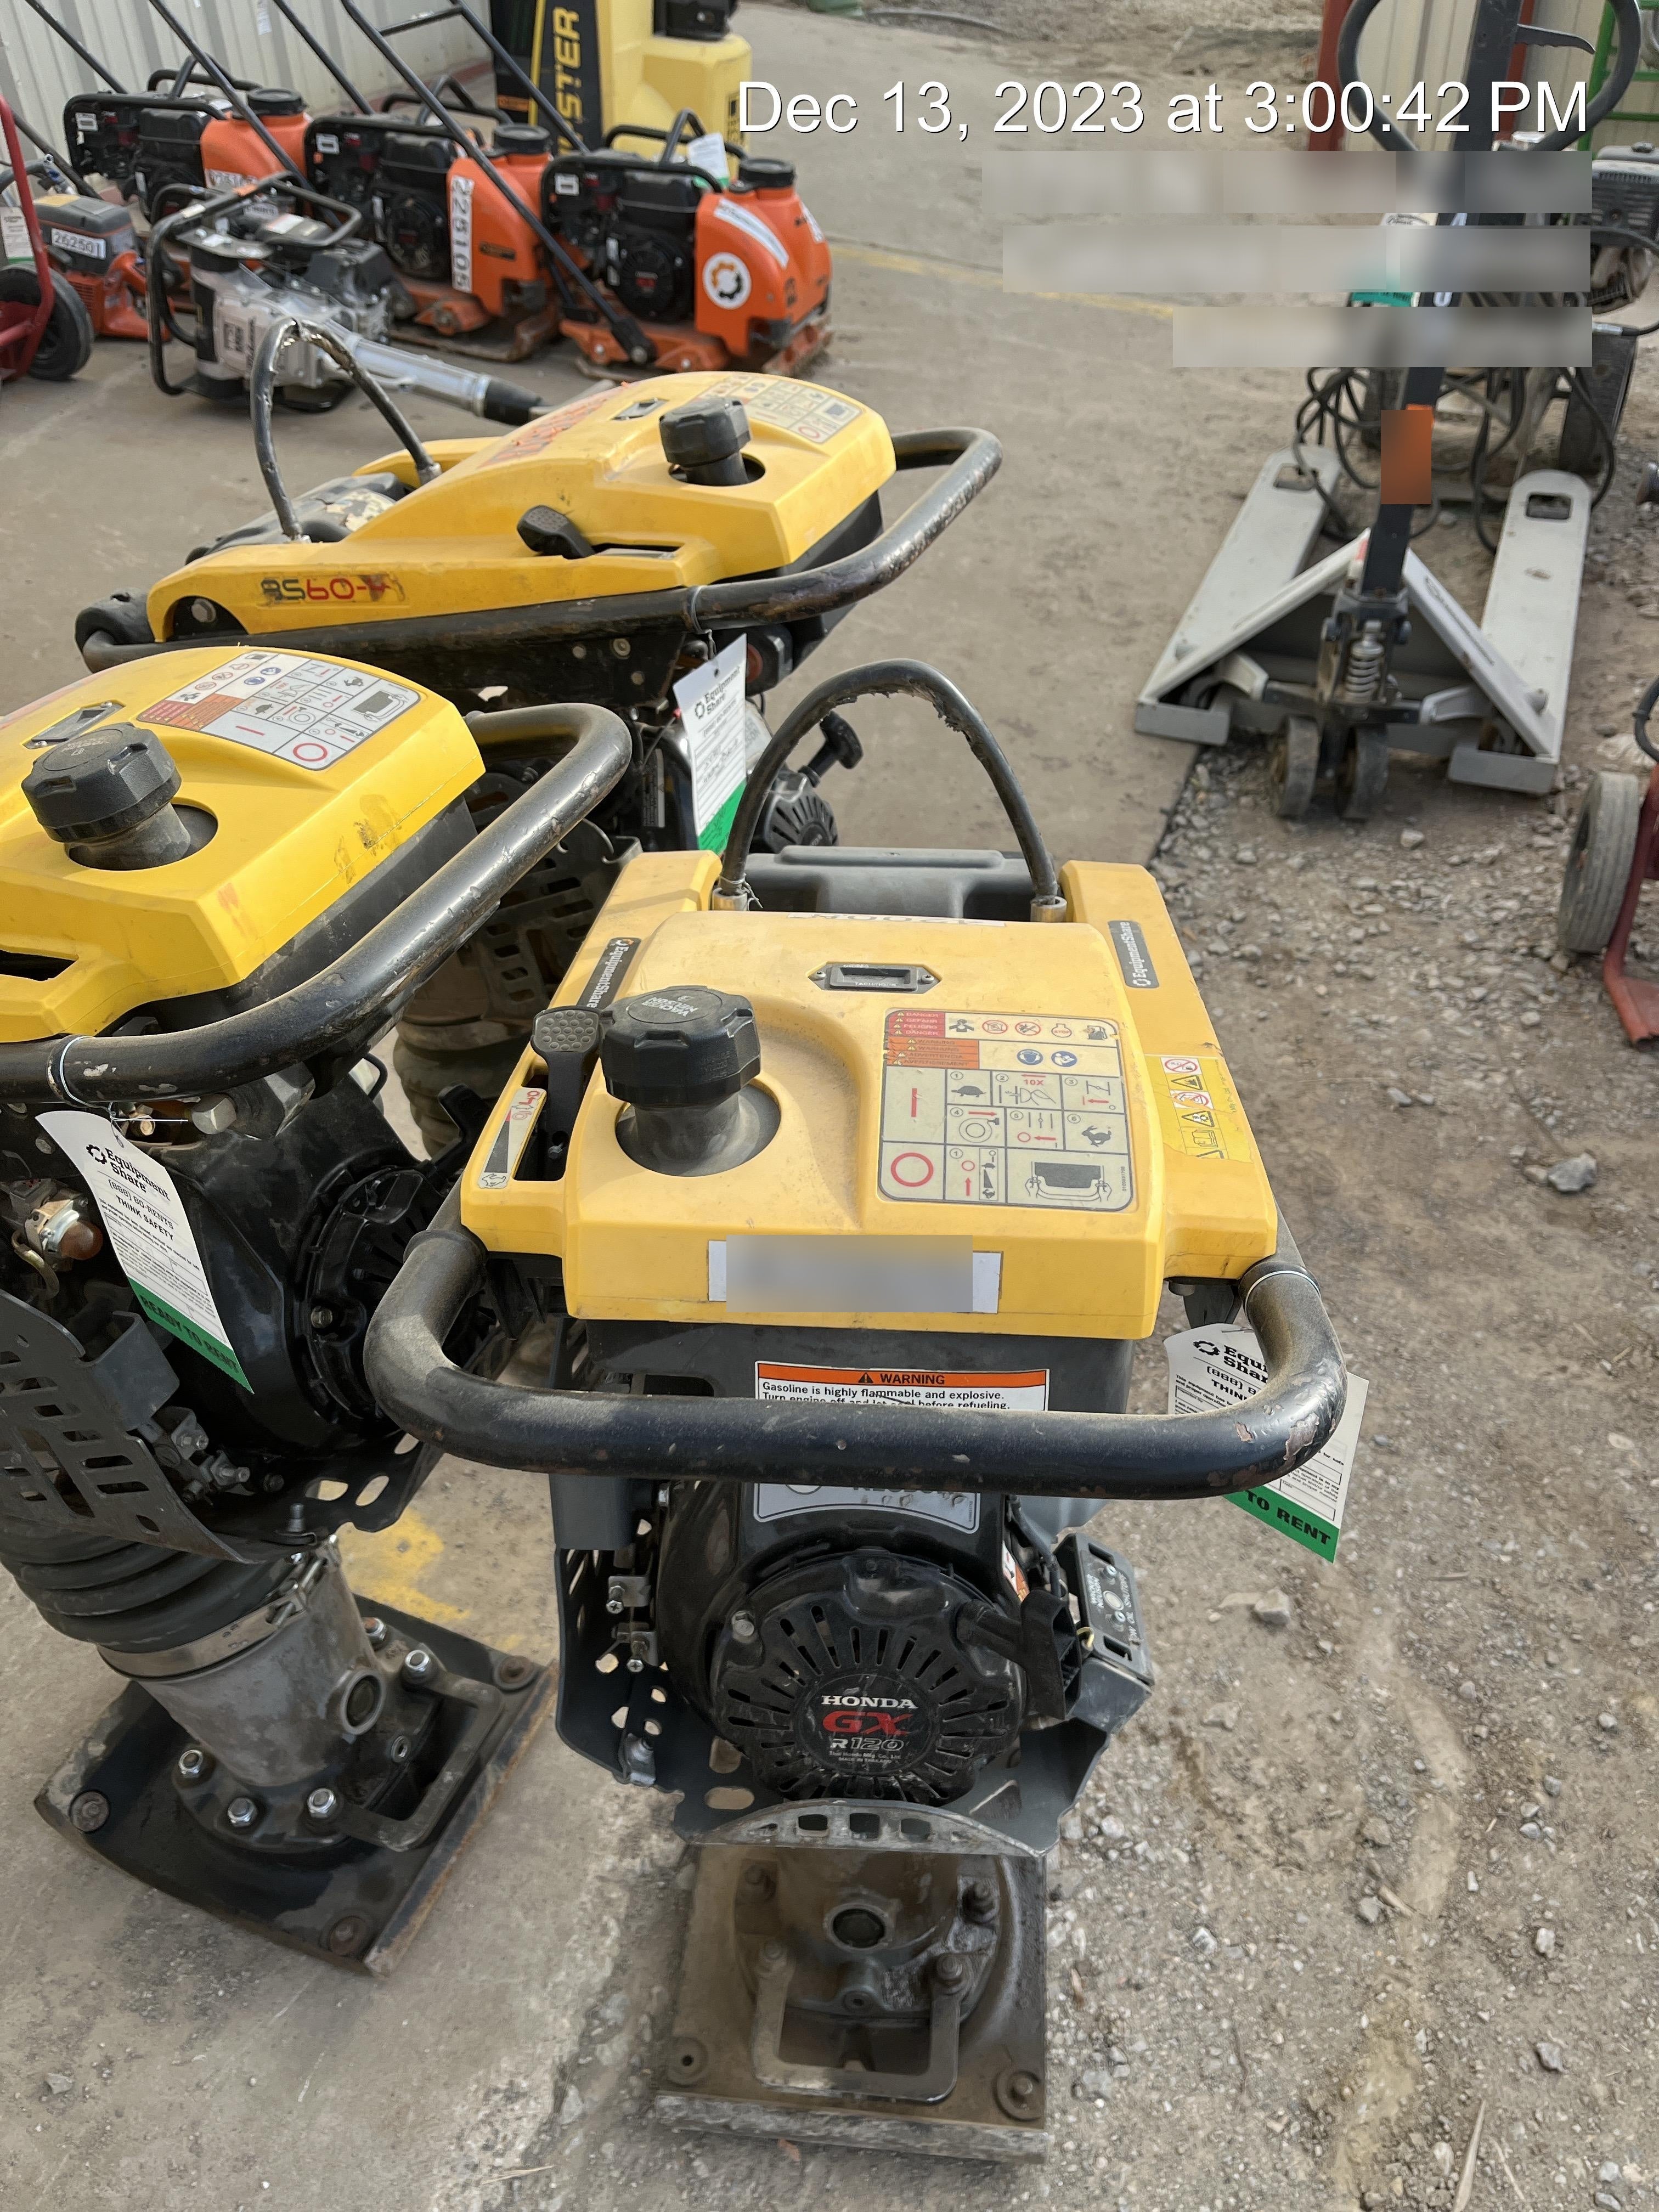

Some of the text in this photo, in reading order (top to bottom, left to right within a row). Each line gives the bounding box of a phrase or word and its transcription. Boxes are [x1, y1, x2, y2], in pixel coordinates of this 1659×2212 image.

[704, 666, 740, 704] Equipment
[707, 693, 726, 714] Share
[1120, 922, 1148, 978] EquipmentShare
[586, 946, 629, 1008] EquipmentShare
[105, 1148, 171, 1201] Equipment
[110, 1161, 146, 1193] Share
[116, 1194, 143, 1218] THINK
[143, 1214, 173, 1241] SAFETY
[183, 1325, 203, 1346] TO
[1223, 1356, 1269, 1384] Shar
[1224, 1345, 1268, 1373] Equi
[763, 1381, 1005, 1401] Gasoline is highly flammable and explosive.
[880, 1373, 945, 1385] WARNING
[1207, 1366, 1243, 1390] (888)
[1211, 1379, 1248, 1401] THIN
[763, 1392, 786, 1400] Turn
[1244, 1489, 1331, 1545] TO RENT
[821, 1696, 919, 1709] HONDA
[823, 1711, 913, 1736] GX
